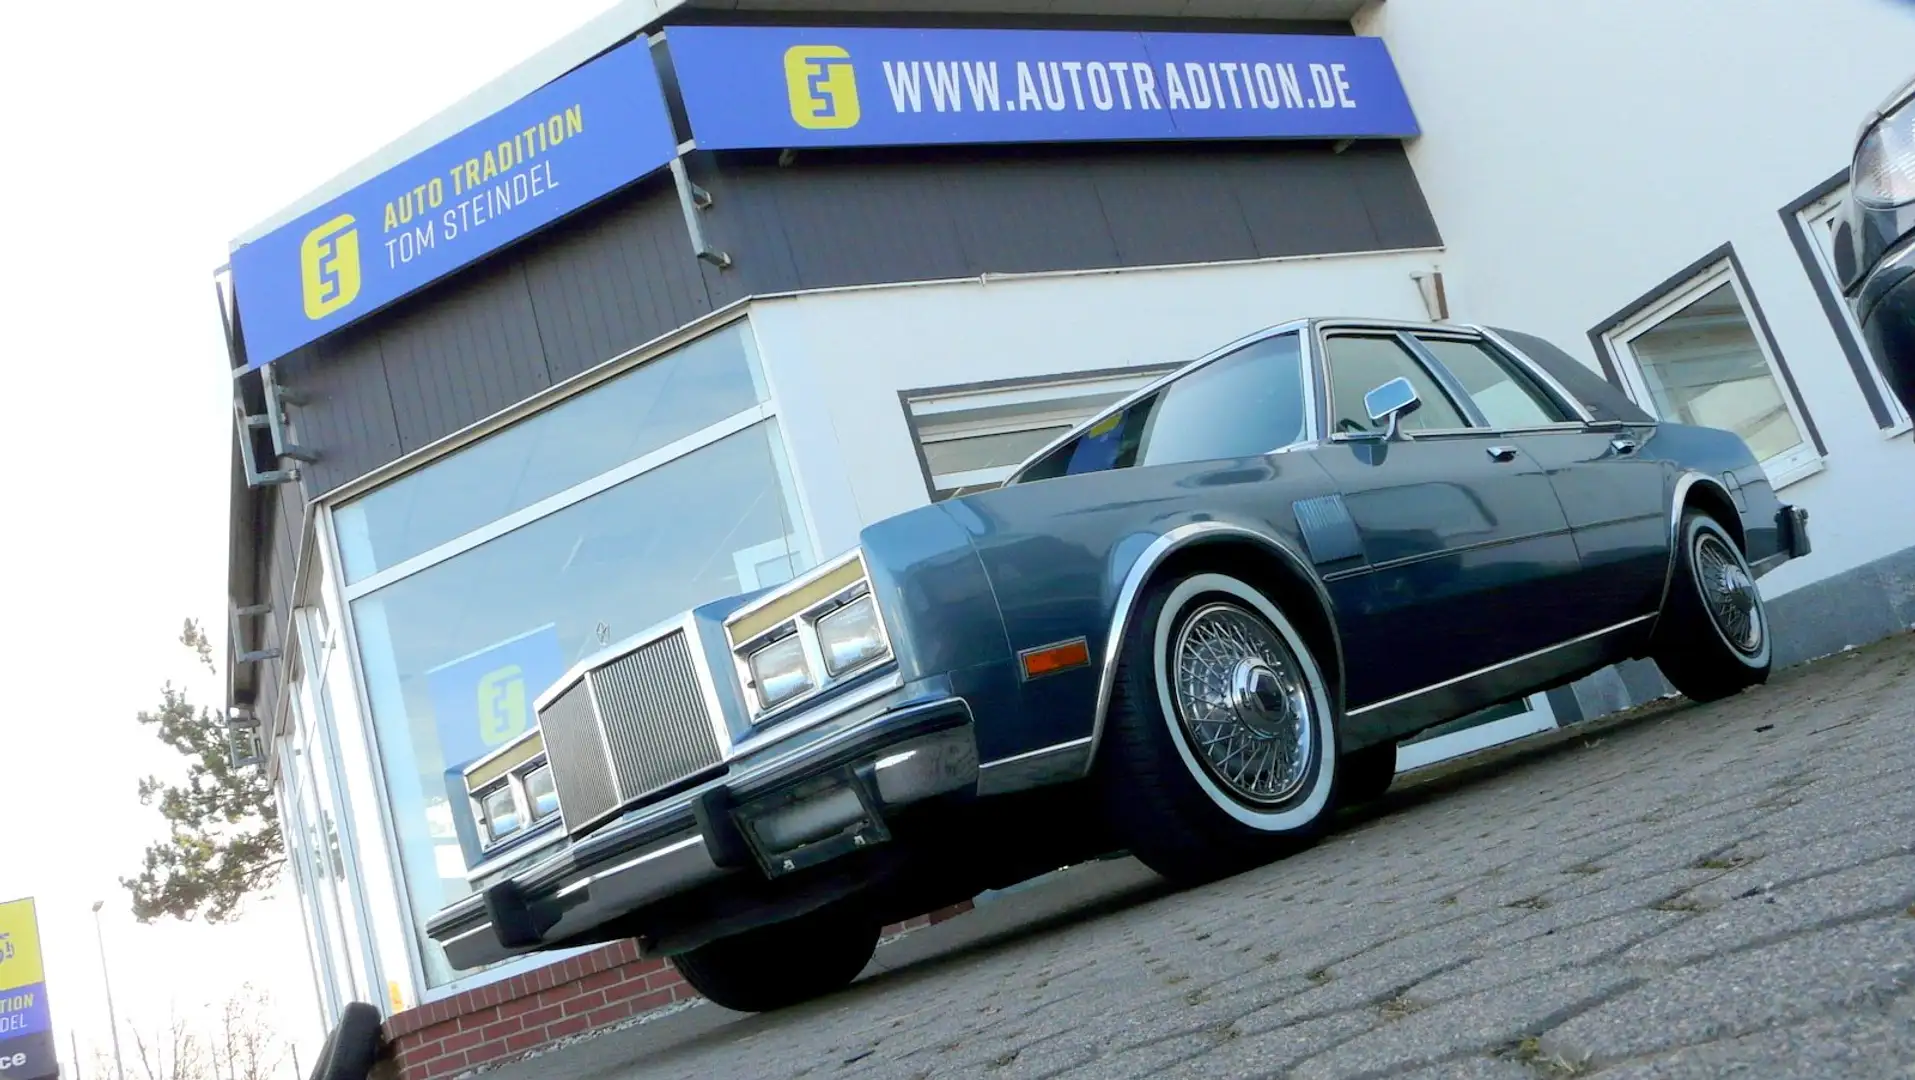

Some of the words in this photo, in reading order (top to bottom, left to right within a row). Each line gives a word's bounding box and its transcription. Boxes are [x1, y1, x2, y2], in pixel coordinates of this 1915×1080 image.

[882, 60, 1357, 113] WWW.AUTOTRADITION.DE
[383, 176, 444, 234] AUTO
[449, 103, 584, 196] TRADITION
[384, 219, 436, 270] TOM
[442, 159, 560, 241] STEINDEL
